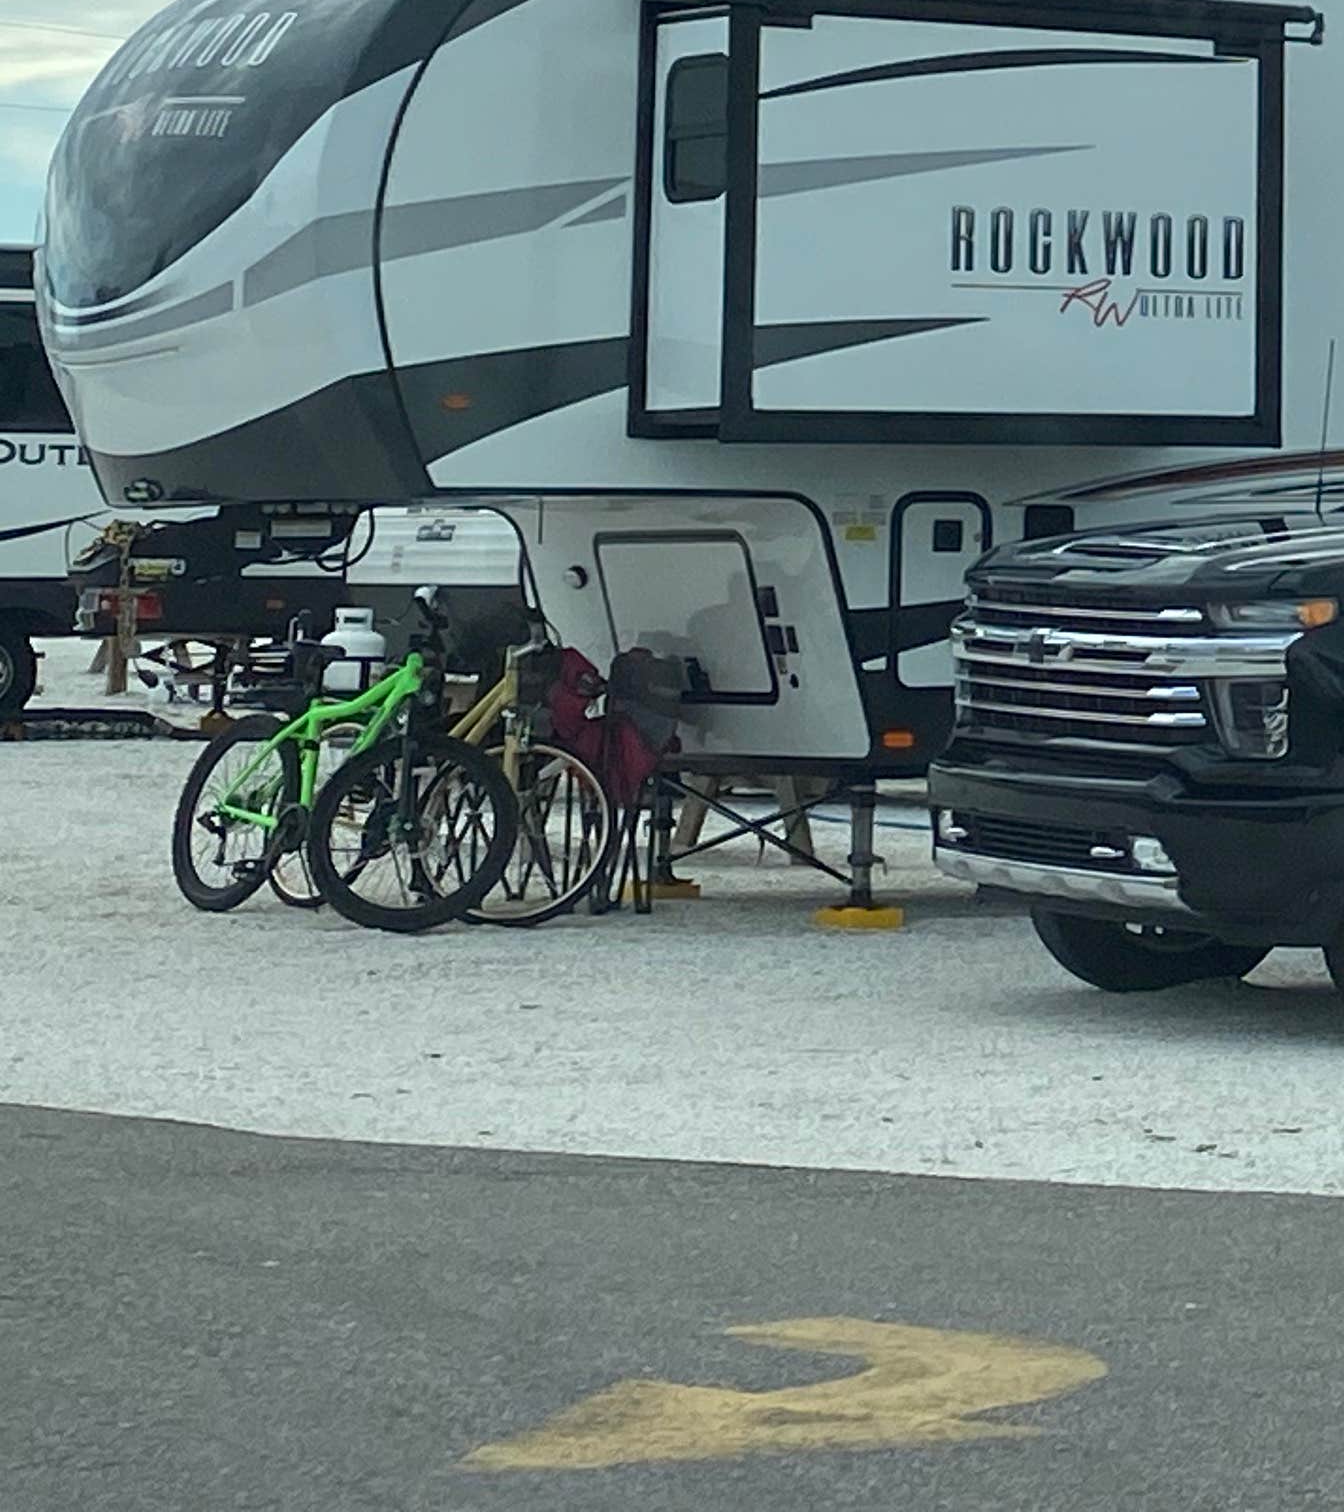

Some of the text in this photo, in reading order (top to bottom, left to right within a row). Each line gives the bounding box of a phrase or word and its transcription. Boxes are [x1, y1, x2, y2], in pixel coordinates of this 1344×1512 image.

[951, 205, 1245, 280] ROCKWOOD
[1140, 294, 1243, 320] ULTRA LITE
